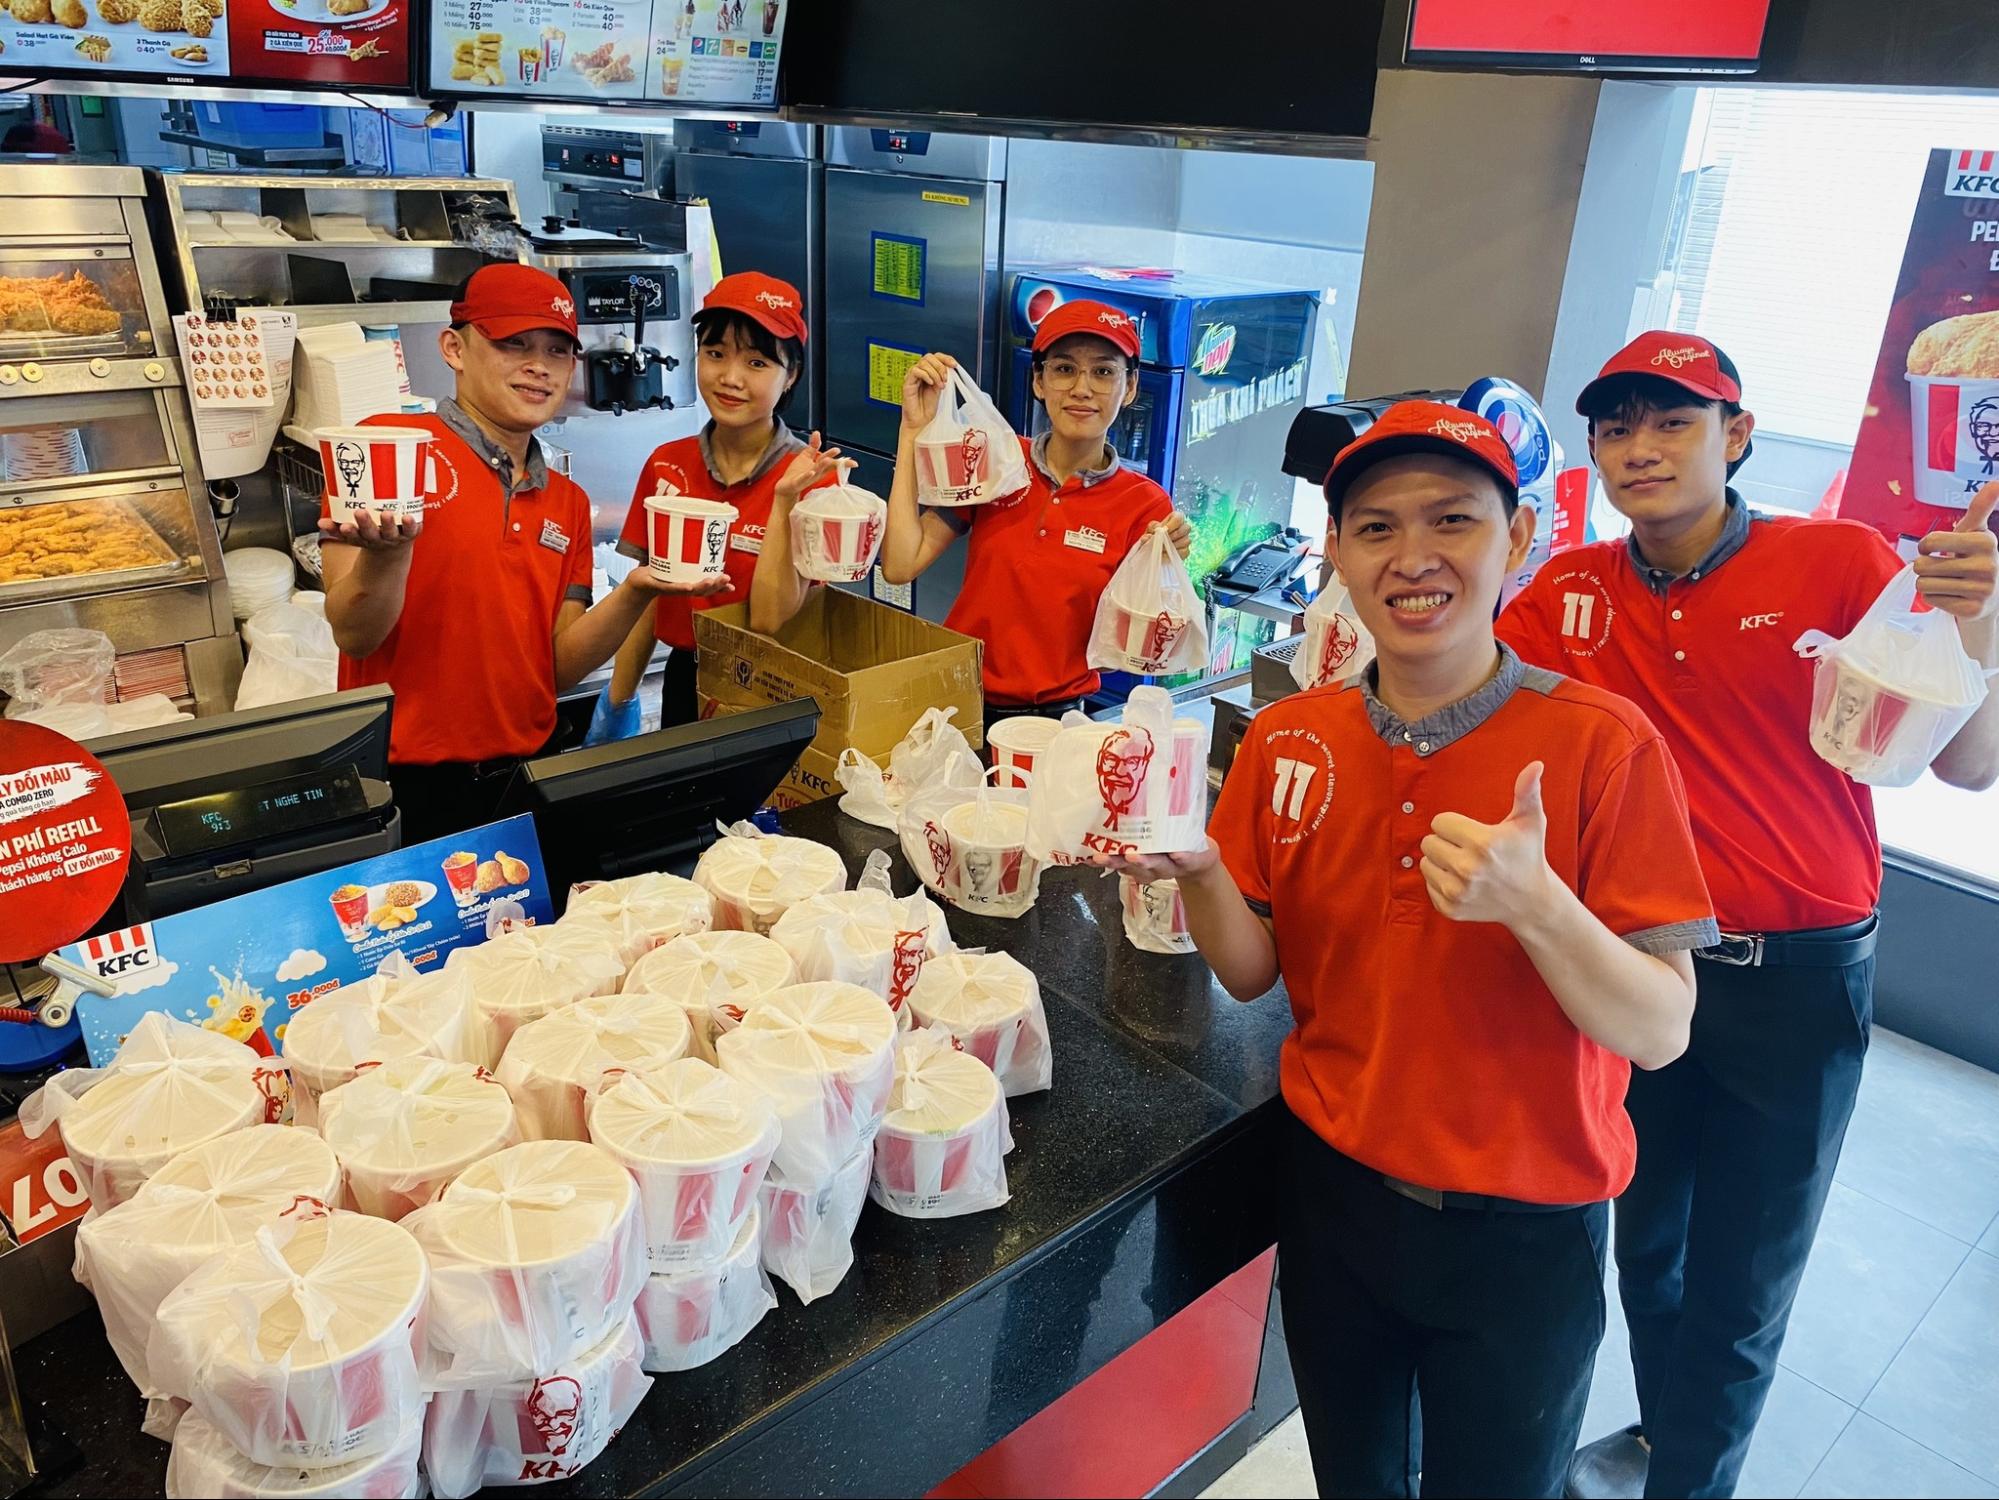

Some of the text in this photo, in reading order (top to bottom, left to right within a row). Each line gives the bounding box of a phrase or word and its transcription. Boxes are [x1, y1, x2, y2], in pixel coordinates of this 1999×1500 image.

[393, 340, 404, 374] KFC
[1650, 347, 1695, 365] Always
[1428, 418, 1476, 435] Always
[344, 501, 367, 510] KFC
[955, 486, 982, 501] KFC
[742, 524, 766, 536] KFC
[703, 565, 719, 573] KFC
[1579, 570, 1590, 580] of
[1561, 592, 1595, 639] 11
[1740, 613, 1778, 631] KFC
[1266, 729, 1290, 745] Home
[1293, 728, 1305, 738] of
[1306, 732, 1320, 745] the
[15, 771, 40, 794] ĐỔI
[41, 767, 72, 787] MÀU
[801, 770, 831, 795] KFC
[1272, 756, 1318, 822] 11
[5, 794, 33, 808] COMBO
[34, 788, 54, 800] ZERO
[201, 788, 324, 824] KFC NGHE TIN
[12, 827, 45, 856] PHÍ
[45, 816, 103, 846] REFILL
[0, 843, 88, 877] epsi Không Calo
[26, 870, 53, 885] hàng
[52, 866, 64, 877] có
[68, 862, 81, 873] LY
[80, 855, 96, 869] ĐỔI
[96, 851, 115, 863] MÀU
[97, 948, 149, 977] KFC
[287, 980, 340, 1008] 36.000đ
